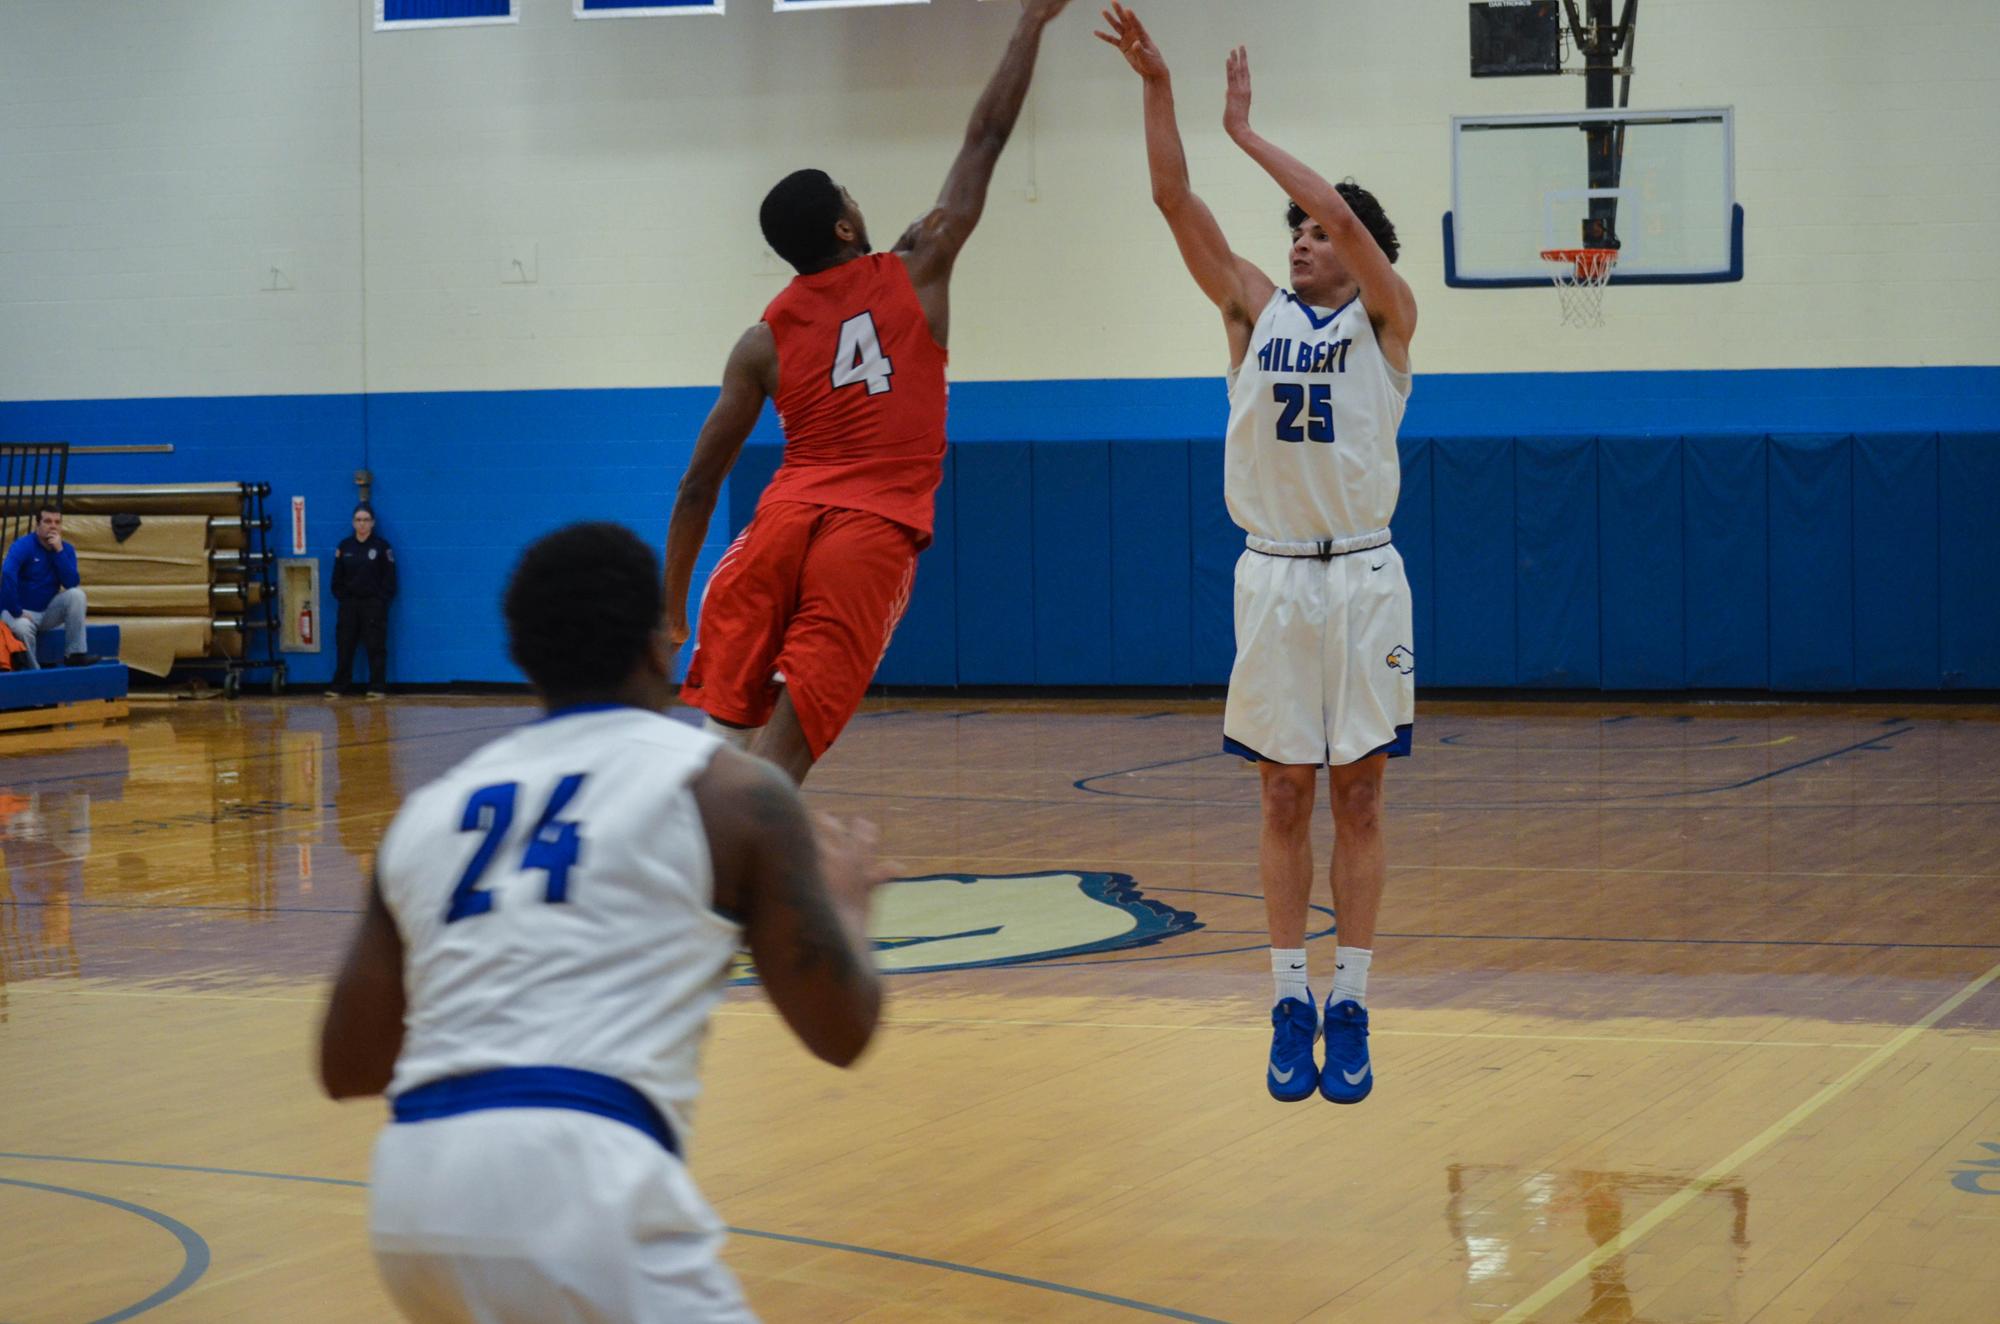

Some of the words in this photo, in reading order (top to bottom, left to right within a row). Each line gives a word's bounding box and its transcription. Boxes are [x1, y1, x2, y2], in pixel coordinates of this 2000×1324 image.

[831, 310, 894, 396] 4
[1274, 384, 1335, 443] 25
[445, 773, 587, 923] 24
